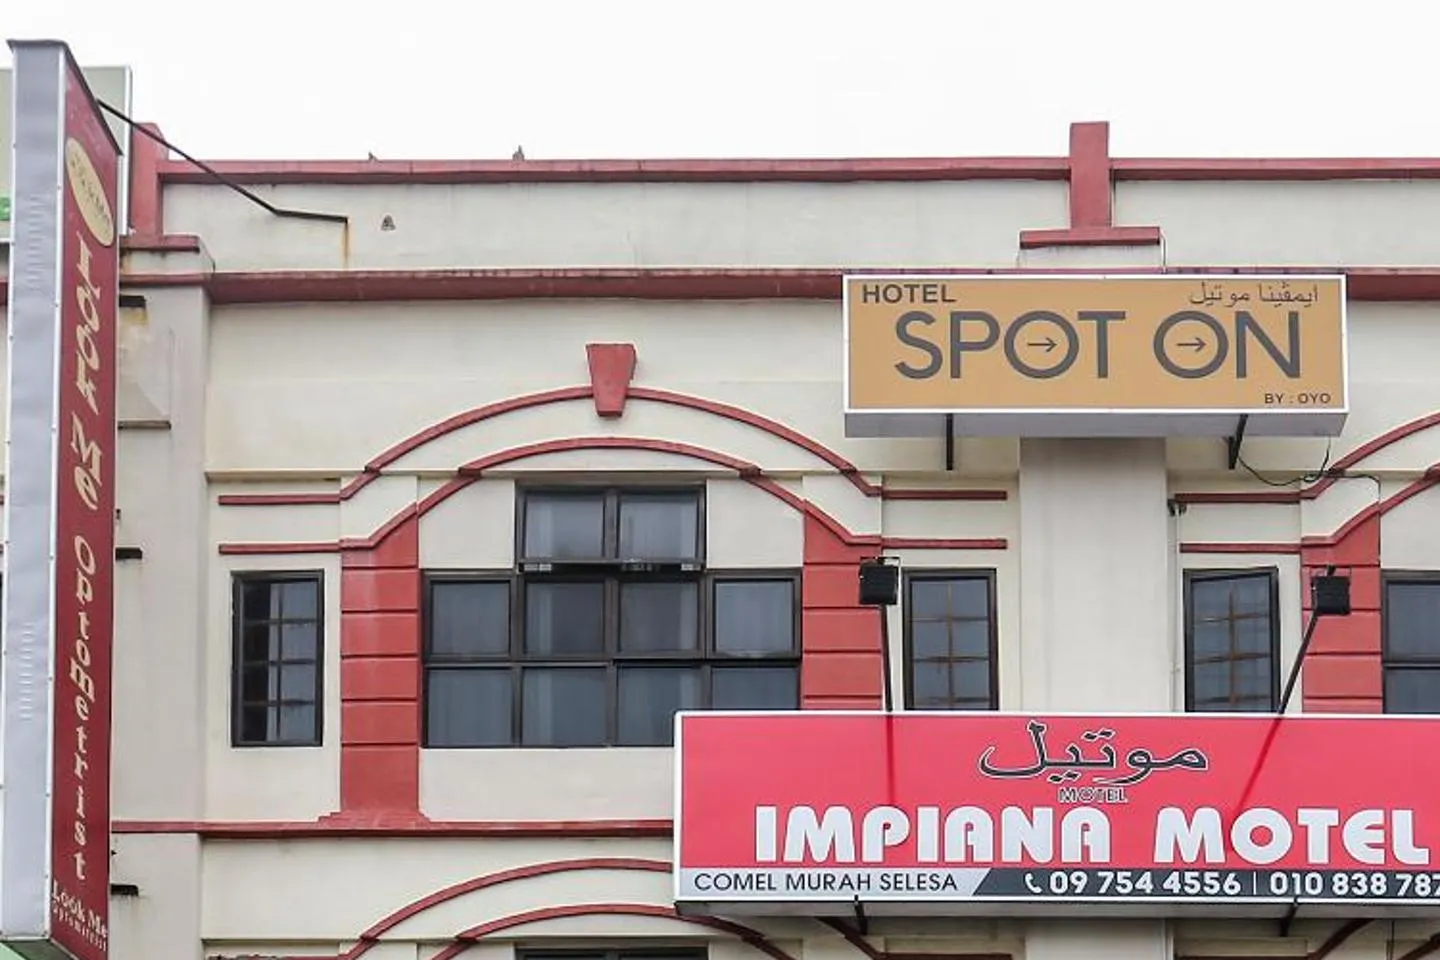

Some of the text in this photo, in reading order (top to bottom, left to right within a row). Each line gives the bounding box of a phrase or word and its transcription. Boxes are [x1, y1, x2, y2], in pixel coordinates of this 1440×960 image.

[861, 283, 957, 304] HOTEL
[893, 310, 1302, 380] SPOT ON
[1263, 393, 1286, 405] BY
[1297, 393, 1332, 405] OYO
[977, 719, 1209, 785] موتيل
[1056, 787, 1128, 803] MOTEL
[754, 804, 1431, 866] IMPIANA MOTEL
[693, 872, 958, 892] COMEL MURAH SELESA
[1048, 870, 1089, 895] 09
[1097, 871, 1154, 895] 754
[1161, 871, 1242, 895] 4556
[1269, 872, 1324, 897] 010
[1332, 872, 1388, 897] 838
